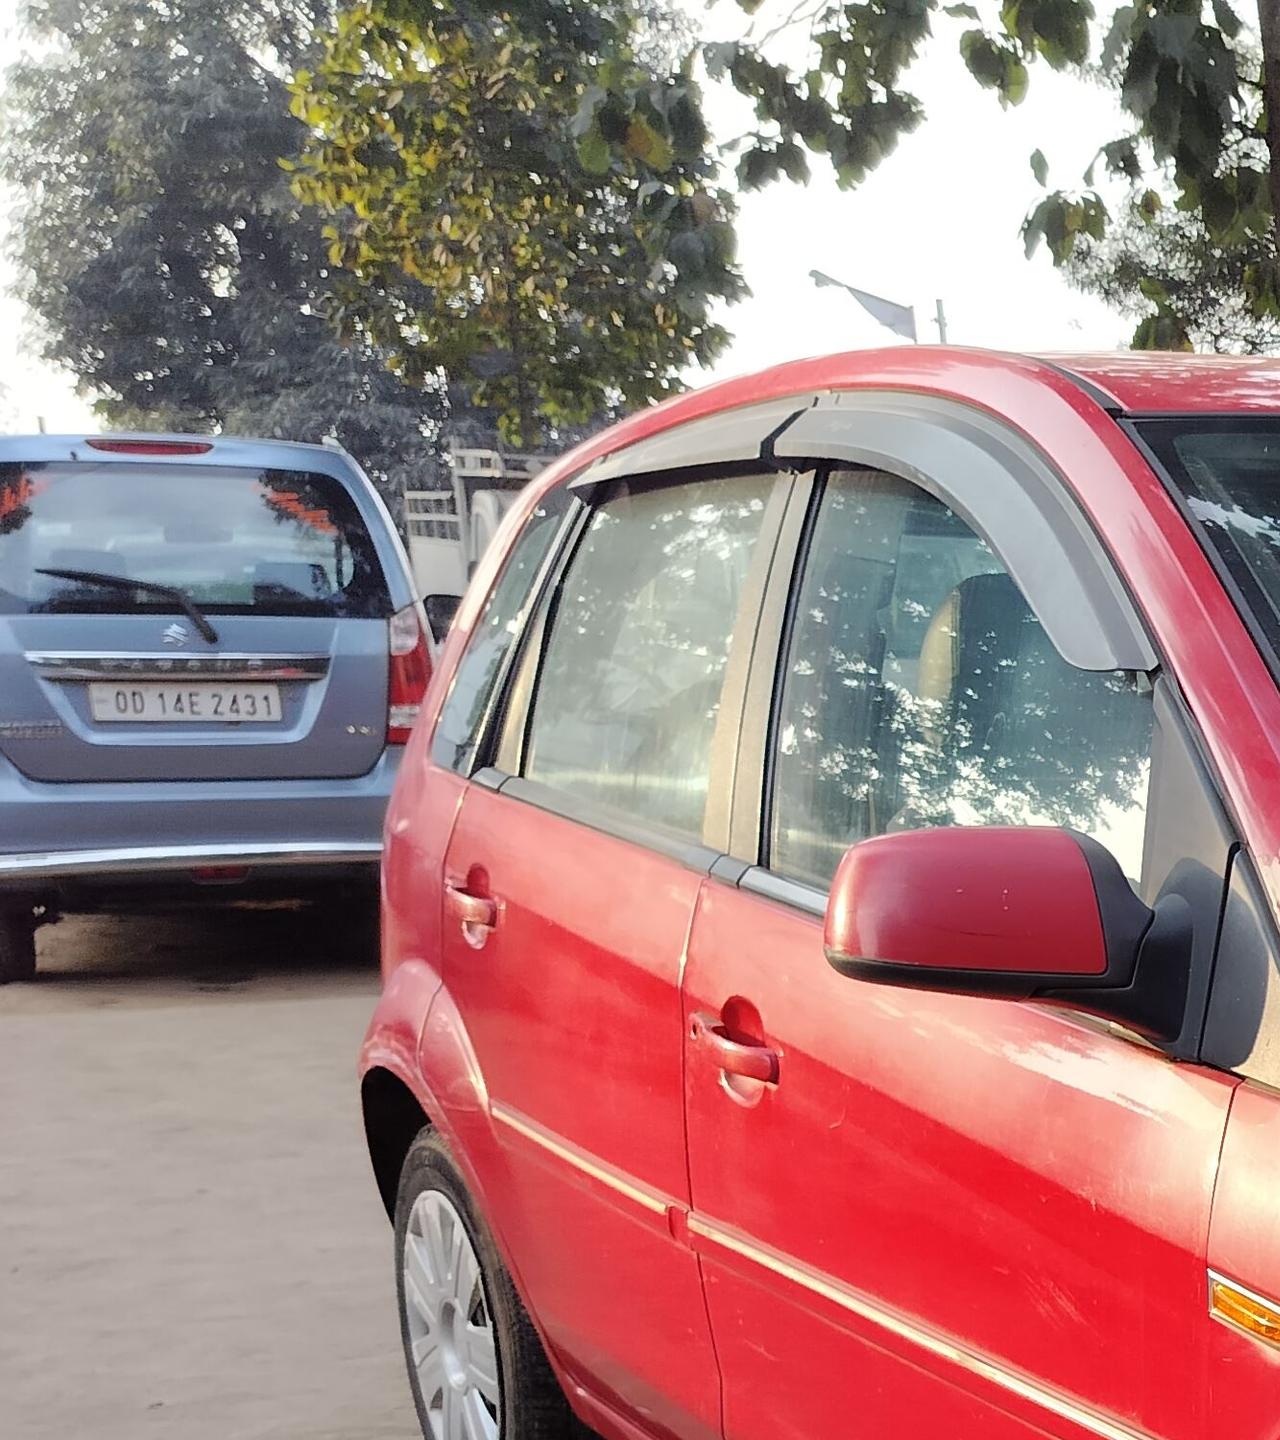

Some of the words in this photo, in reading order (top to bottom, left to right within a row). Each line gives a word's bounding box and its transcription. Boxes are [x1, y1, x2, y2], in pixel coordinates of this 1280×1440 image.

[115, 690, 145, 715] OD
[159, 691, 201, 715] 14E
[210, 692, 272, 717] 2431
